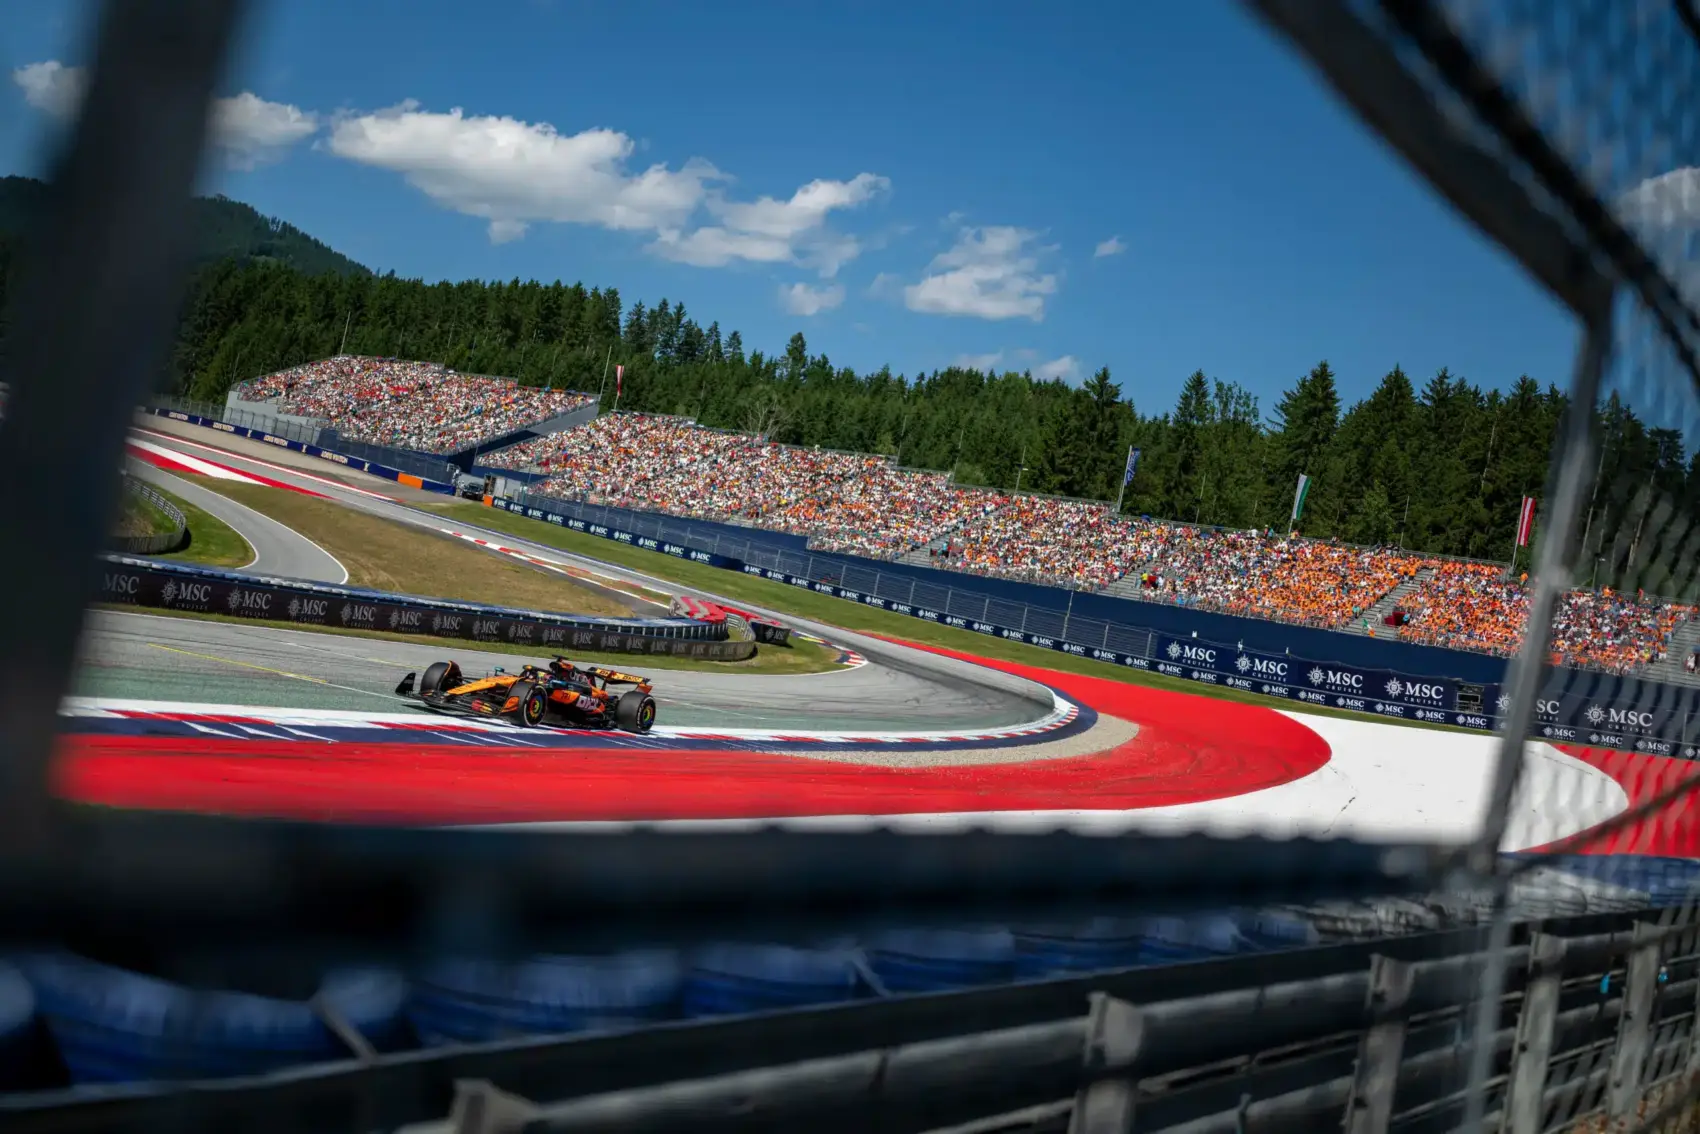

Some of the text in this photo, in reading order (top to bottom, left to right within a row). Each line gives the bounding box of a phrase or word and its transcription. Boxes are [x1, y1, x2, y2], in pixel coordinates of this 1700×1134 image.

[620, 532, 632, 540] MSC
[644, 539, 657, 547] MSC
[670, 546, 684, 554] MSC
[697, 552, 710, 561] MSC
[102, 573, 139, 593] MSC
[797, 578, 809, 586] MSC
[178, 582, 212, 602] MSC
[846, 591, 859, 599] MSC
[243, 591, 271, 609] MSC
[871, 597, 884, 605] MSC
[301, 599, 327, 615] MSC
[898, 604, 911, 612] MSC
[352, 605, 376, 621] MSC
[924, 610, 938, 619] MSC
[400, 611, 421, 626] MSC
[442, 616, 461, 629] MSC
[952, 617, 966, 625] MSC
[481, 620, 499, 634] MSC
[516, 625, 533, 637] MSC
[980, 623, 994, 632] MSC
[550, 629, 565, 640] MSC
[1009, 630, 1024, 639] MSC
[1039, 637, 1053, 646] MSC
[1070, 644, 1085, 653] MSC
[1101, 650, 1116, 660] MSC
[1183, 646, 1216, 662] MSC
[1133, 658, 1149, 667] MSC
[1182, 659, 1215, 668] CRUISES
[1253, 659, 1288, 676] MSC
[1166, 665, 1182, 674] MSC
[1200, 672, 1217, 680] MSC
[1252, 672, 1286, 682] CRUISES
[1326, 670, 1363, 687] MSC
[1235, 678, 1252, 688] MSC
[1270, 685, 1288, 695] MSC
[1326, 685, 1362, 694] CRUISES
[1405, 682, 1444, 699] MSC
[1307, 691, 1325, 701] MSC
[1345, 697, 1364, 708] MSC
[1404, 697, 1442, 706] CRUISES
[1536, 699, 1560, 714] SC
[1384, 704, 1404, 713] MSC
[1425, 710, 1445, 720] MSC
[1608, 708, 1653, 726] MSC
[1466, 716, 1487, 726] MSC
[1553, 728, 1576, 738] MSC
[1608, 724, 1652, 734] CRUISES
[1601, 735, 1623, 745] MSC
[1647, 741, 1670, 752] MSC
